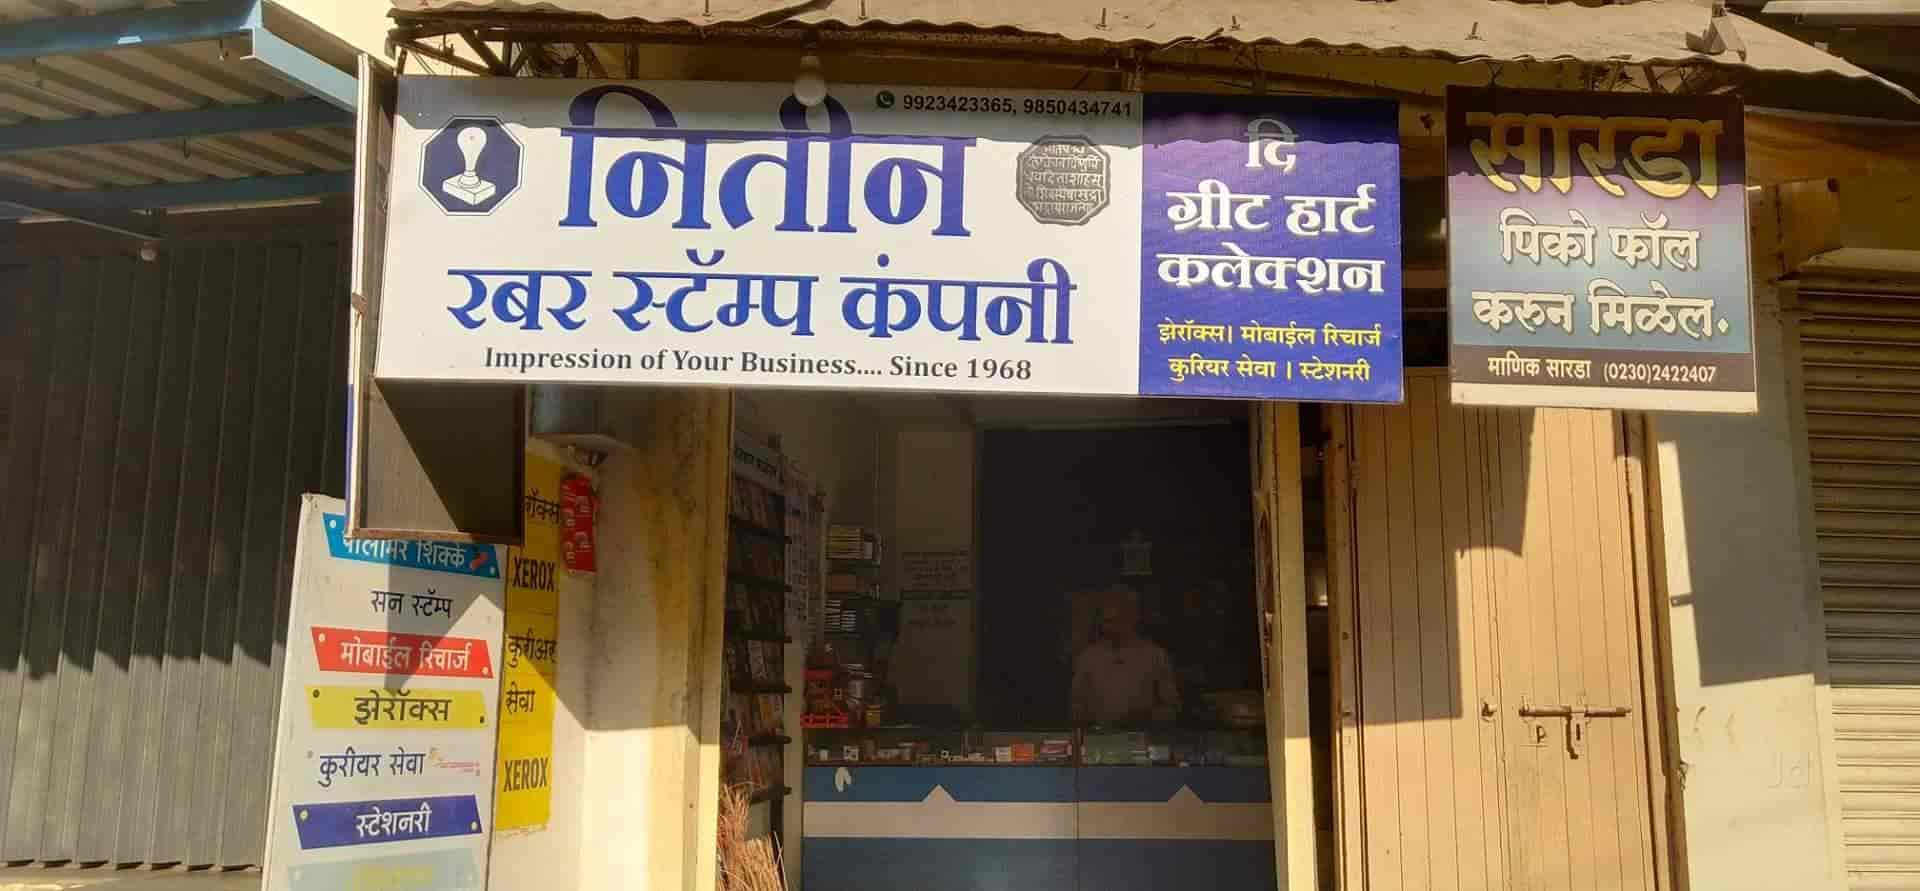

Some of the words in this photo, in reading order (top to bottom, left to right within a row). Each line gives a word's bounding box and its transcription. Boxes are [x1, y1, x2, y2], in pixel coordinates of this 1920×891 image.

[903, 94, 1017, 114] 9923423365,
[1023, 98, 1132, 117] 9850434741
[559, 85, 976, 236] नितीन
[1244, 118, 1299, 173] दि
[1466, 112, 1724, 199] सारडा
[1166, 179, 1271, 232] ग्रीट
[1283, 184, 1377, 236] हार्ट
[1499, 207, 1597, 266] पिको
[1608, 210, 1701, 270] फॉल
[1156, 242, 1386, 294] कलेक्शन
[447, 269, 592, 330] रबर
[613, 249, 819, 336] स्टॅम्प
[840, 253, 1077, 344] कंपनी
[1240, 320, 1316, 348] मोबाईल
[1323, 322, 1382, 348] रिचार्ज
[485, 347, 632, 373] Impression
[640, 349, 666, 370] of
[672, 350, 733, 372] Your
[741, 350, 882, 377] Business....
[889, 355, 958, 378] Since
[967, 359, 1032, 380] 1968
[1168, 352, 1229, 382] कुरियर
[1236, 353, 1277, 378] सेवा
[1299, 356, 1371, 381] स्टेशनरी
[1487, 350, 1541, 378] माणिक
[1546, 358, 1592, 379] सारडा
[512, 556, 555, 591] XEROX
[370, 590, 402, 614] सन
[411, 589, 453, 618] स्टॅम्प
[340, 636, 411, 671] मोबाईल
[419, 642, 472, 671] रिचार्ज
[353, 687, 452, 725] झेरॉक्स
[505, 681, 536, 714] सेवा
[318, 746, 382, 787] कुरीयर
[389, 747, 426, 776] सेवा
[503, 757, 549, 792] XEROX
[355, 801, 432, 838] स्टेशनरी
